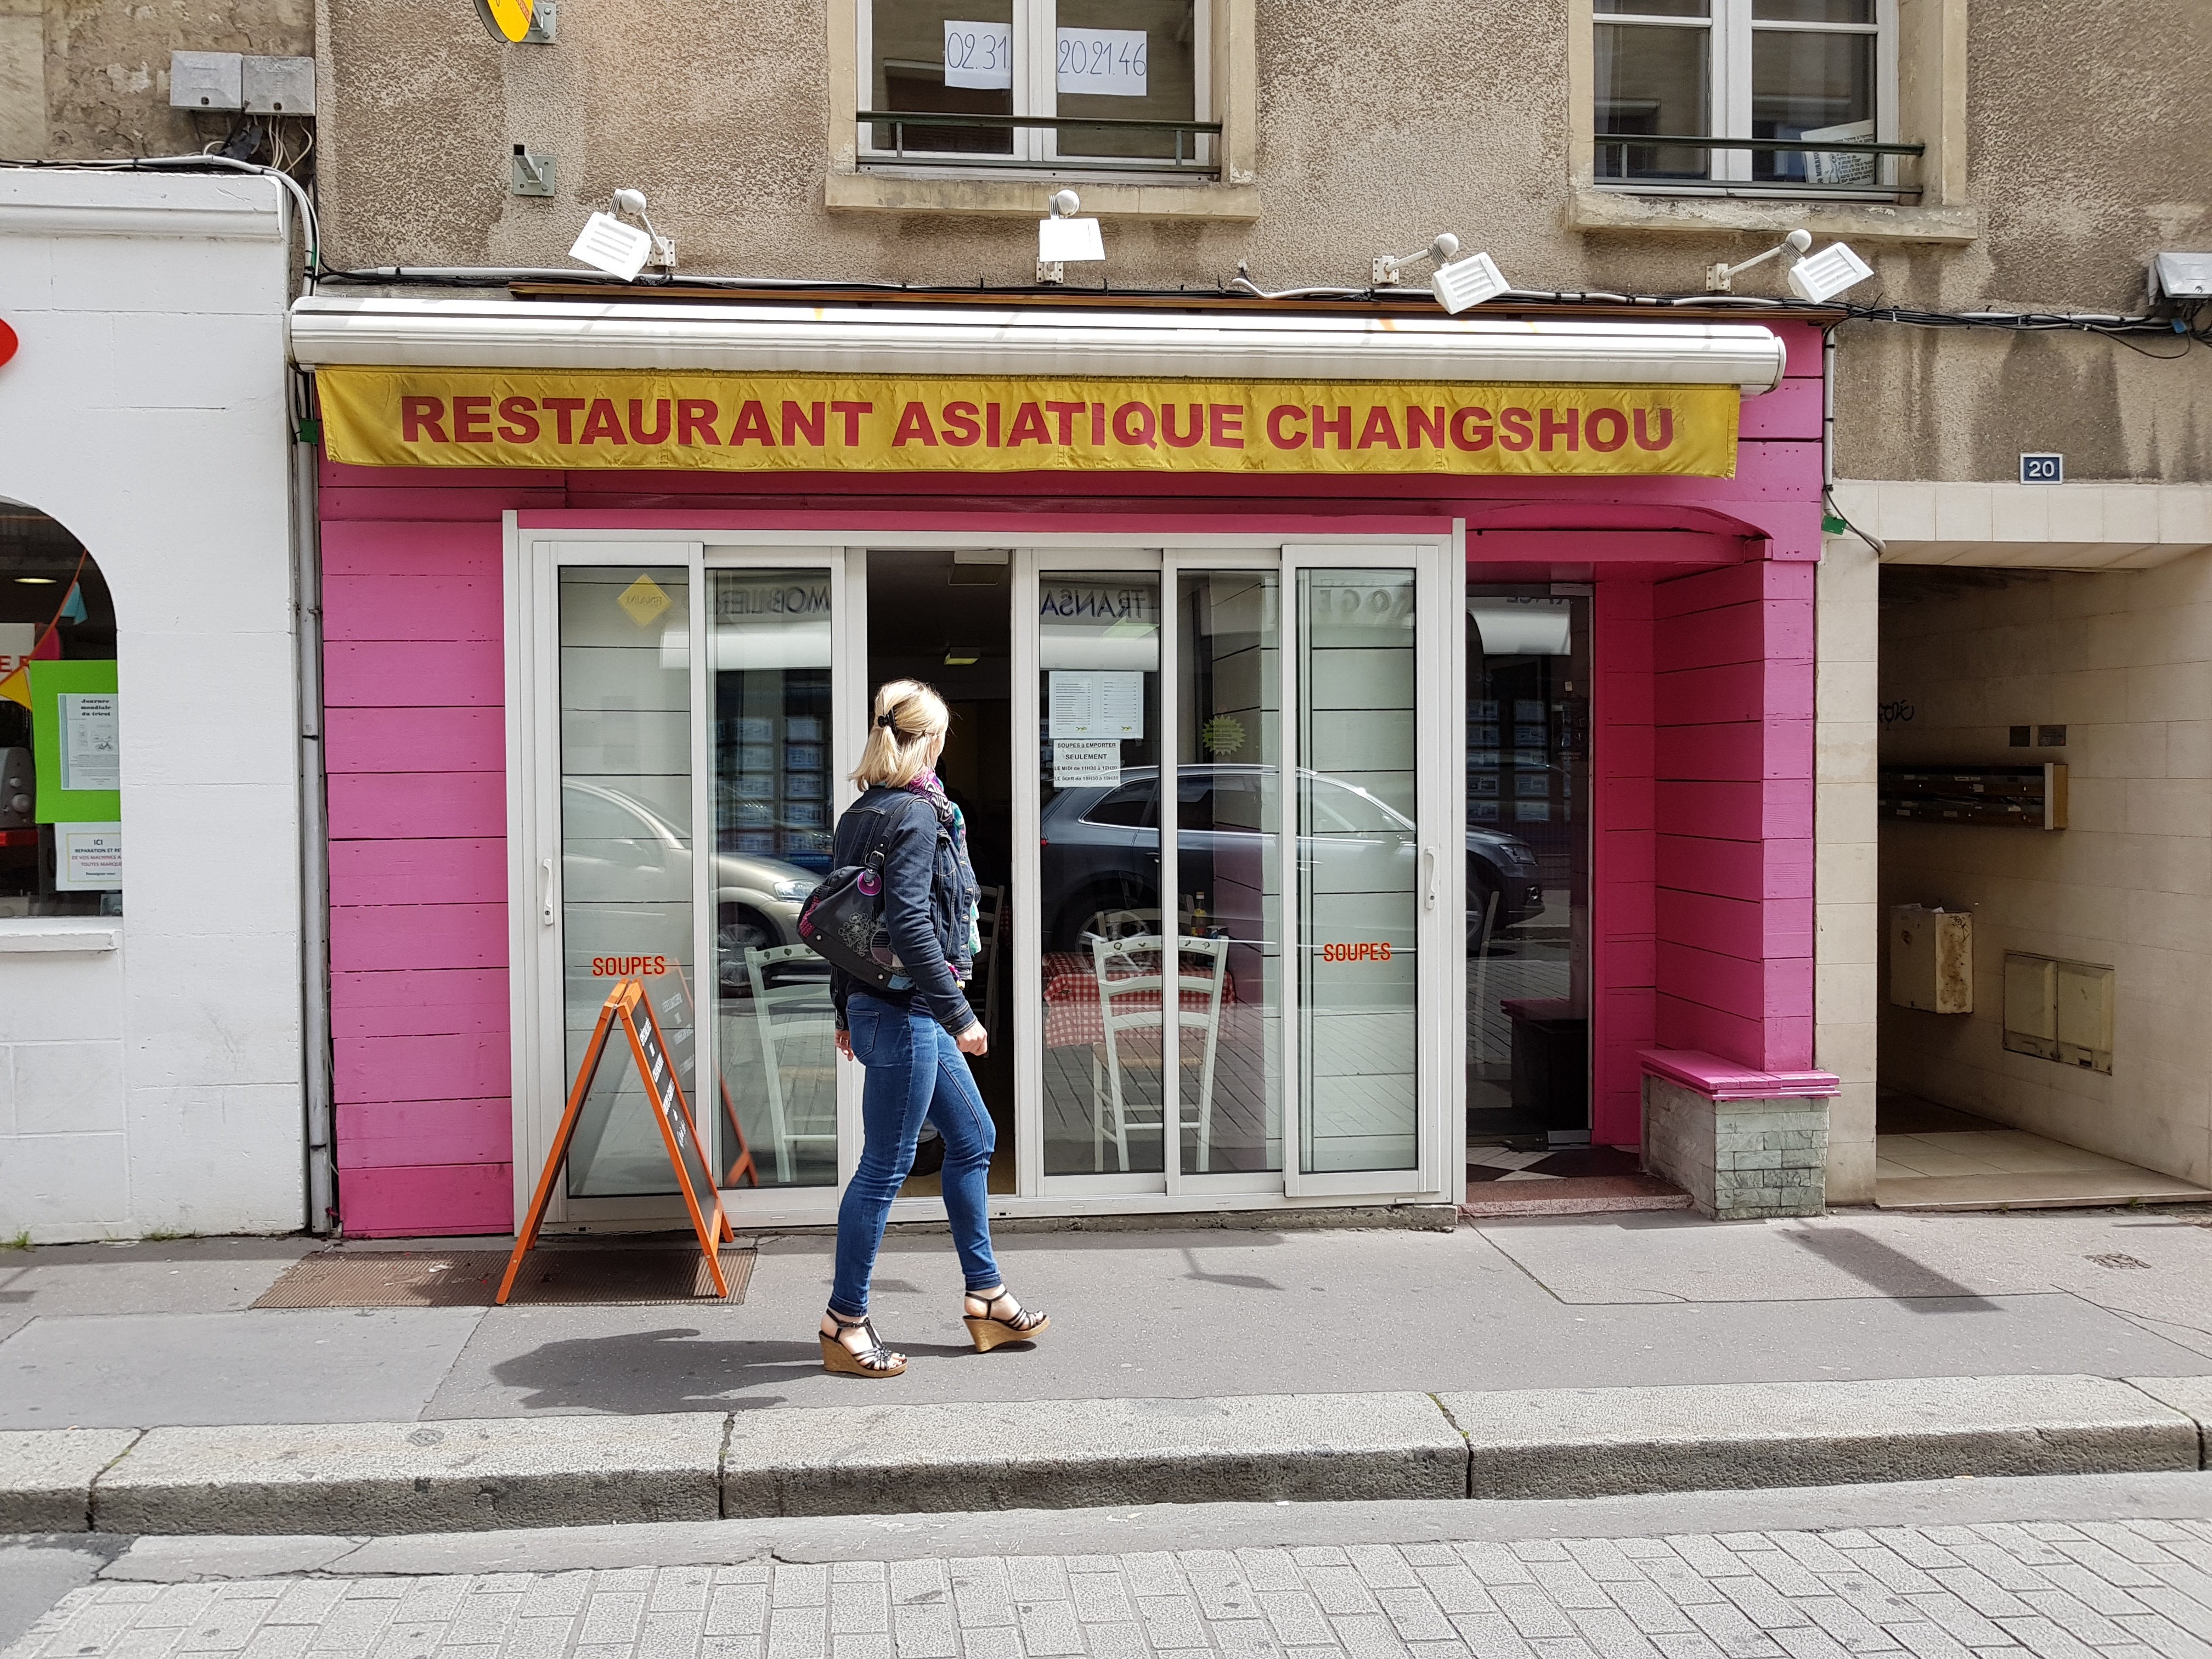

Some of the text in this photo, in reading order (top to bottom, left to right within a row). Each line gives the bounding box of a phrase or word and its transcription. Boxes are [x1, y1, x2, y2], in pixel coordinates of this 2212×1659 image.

[1057, 40, 1147, 76] 20.21.46
[401, 395, 1674, 453] RESTAURANT ASIATIQUE CHANGSHOU
[2028, 460, 2055, 477] 20
[1323, 942, 1391, 962] SOUPES
[592, 956, 665, 976] SOUPES
